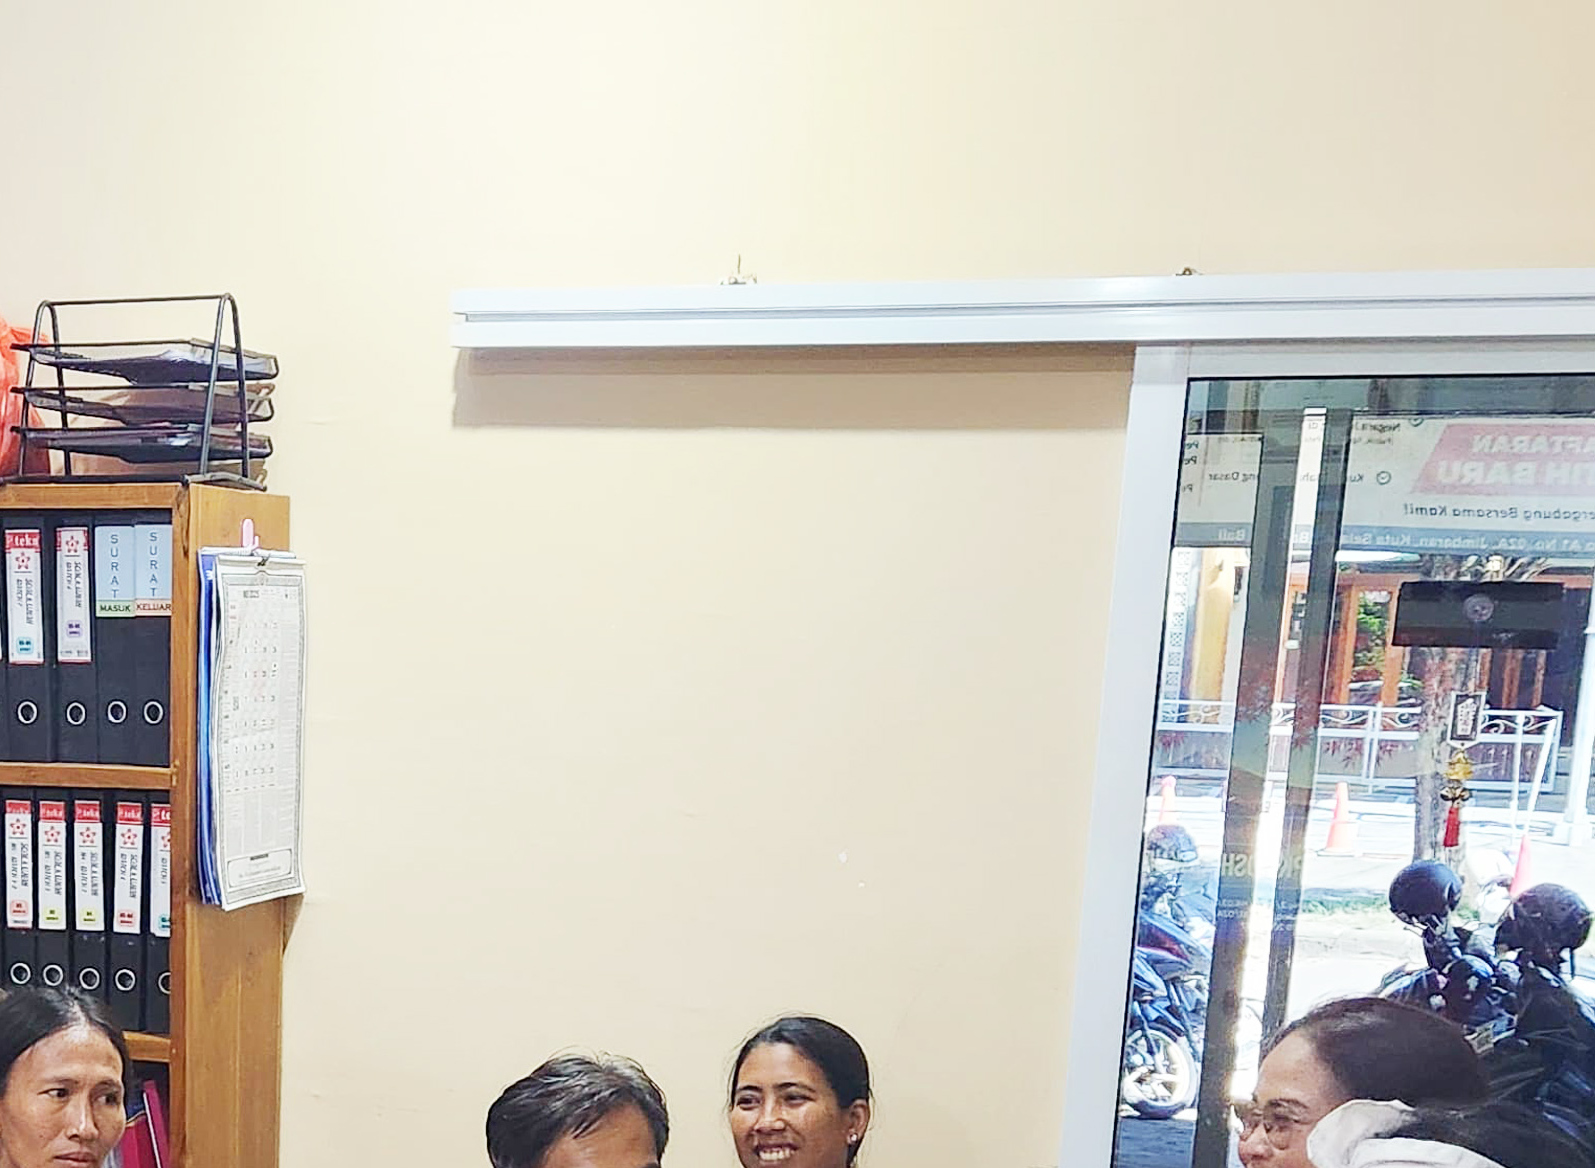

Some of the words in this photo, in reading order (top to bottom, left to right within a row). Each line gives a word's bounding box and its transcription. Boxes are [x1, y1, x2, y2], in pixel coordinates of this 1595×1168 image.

[110, 534, 119, 599] SURAT
[149, 532, 158, 597] SURAT
[100, 604, 131, 612] MASUK
[136, 603, 171, 611] KELUAR
